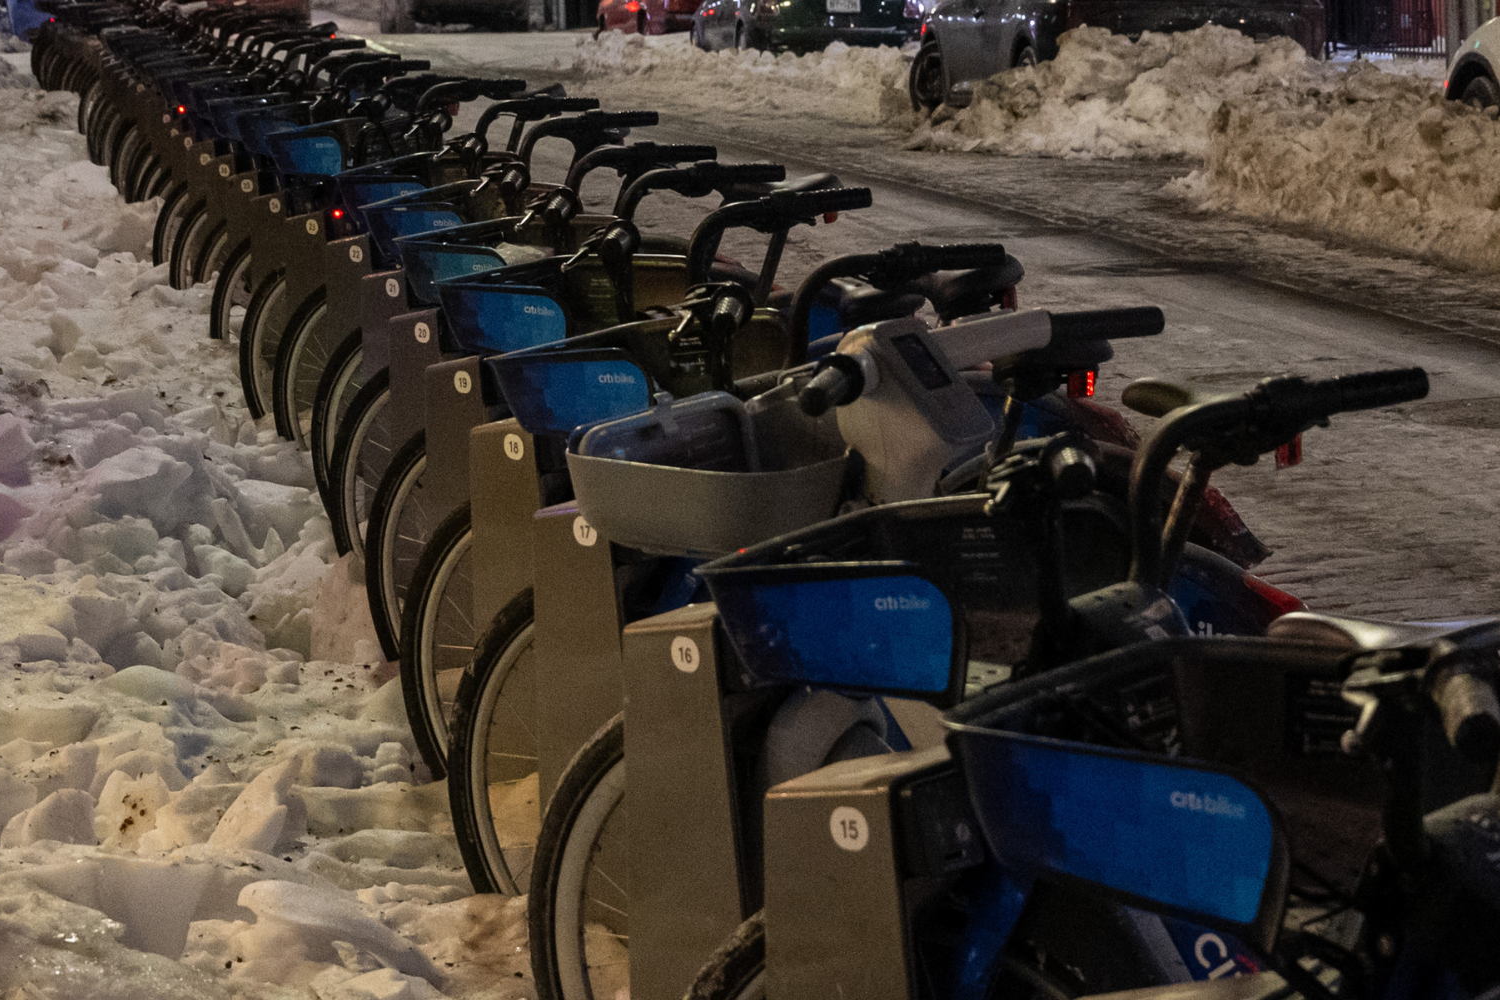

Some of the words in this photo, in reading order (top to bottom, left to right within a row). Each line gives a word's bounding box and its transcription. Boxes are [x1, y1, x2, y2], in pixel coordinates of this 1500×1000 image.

[352, 249, 360, 259] 22
[389, 283, 397, 293] 21
[418, 328, 427, 339] 20
[458, 377, 467, 388] 19
[509, 441, 519, 454] 18
[579, 524, 590, 539] 17
[678, 646, 692, 663] 16
[839, 818, 859, 840] 15
